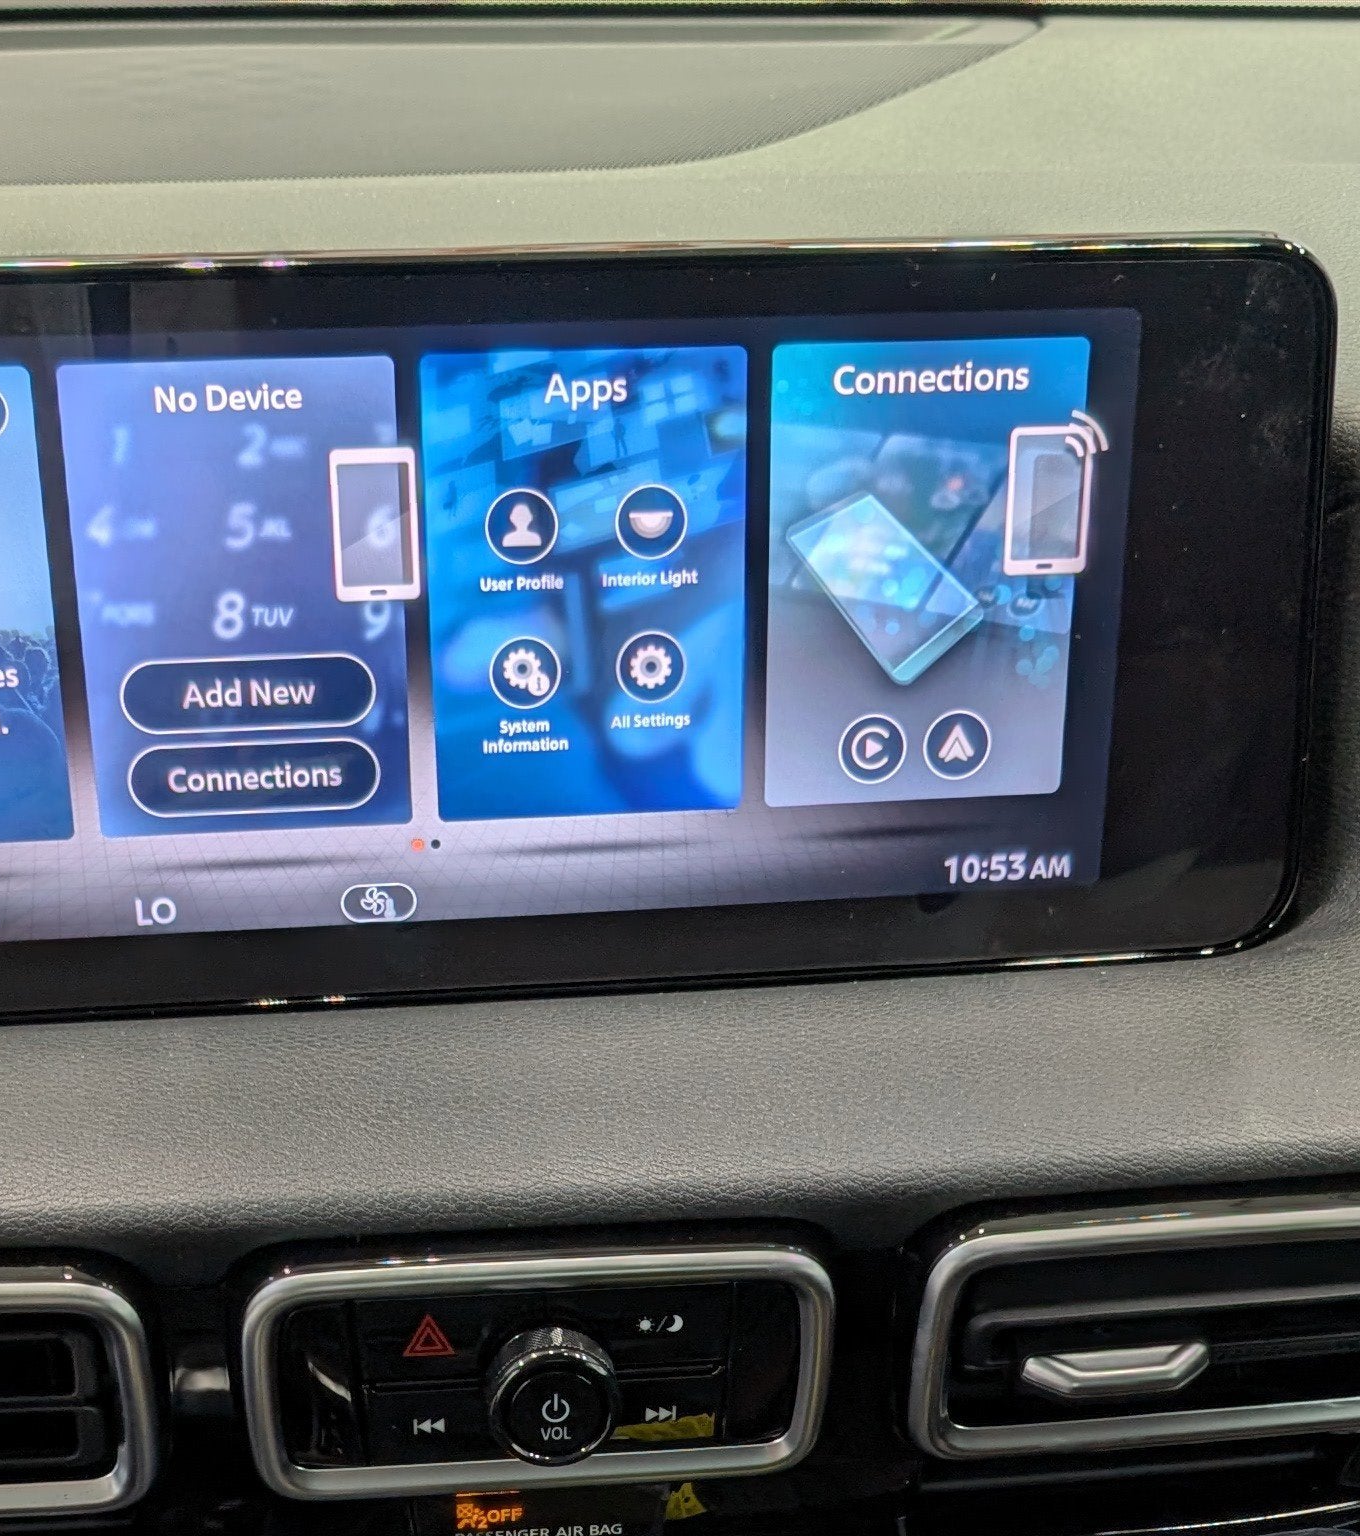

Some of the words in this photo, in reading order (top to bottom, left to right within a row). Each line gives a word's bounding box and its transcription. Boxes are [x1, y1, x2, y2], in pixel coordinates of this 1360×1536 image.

[544, 373, 628, 411] Apps
[832, 361, 1030, 397] Connections
[153, 385, 197, 414] No
[205, 383, 303, 412] Device
[225, 502, 257, 551] 5
[480, 577, 513, 592] User
[516, 574, 564, 591] Profile
[602, 571, 657, 588] Interior
[660, 569, 698, 588] Light
[213, 590, 246, 640] 8
[252, 606, 294, 628] TUV
[182, 678, 242, 709] Add
[250, 679, 315, 708] New
[499, 719, 550, 738] System
[610, 714, 631, 729] All
[634, 713, 691, 731] Settings
[483, 737, 569, 754] Information
[167, 762, 343, 794] Connections
[944, 853, 1030, 886] 10:53
[1029, 852, 1072, 880] AM
[135, 898, 177, 926] LO
[540, 1427, 572, 1442] VOL
[487, 1507, 523, 1523] OFF
[590, 1523, 623, 1536] BAG
